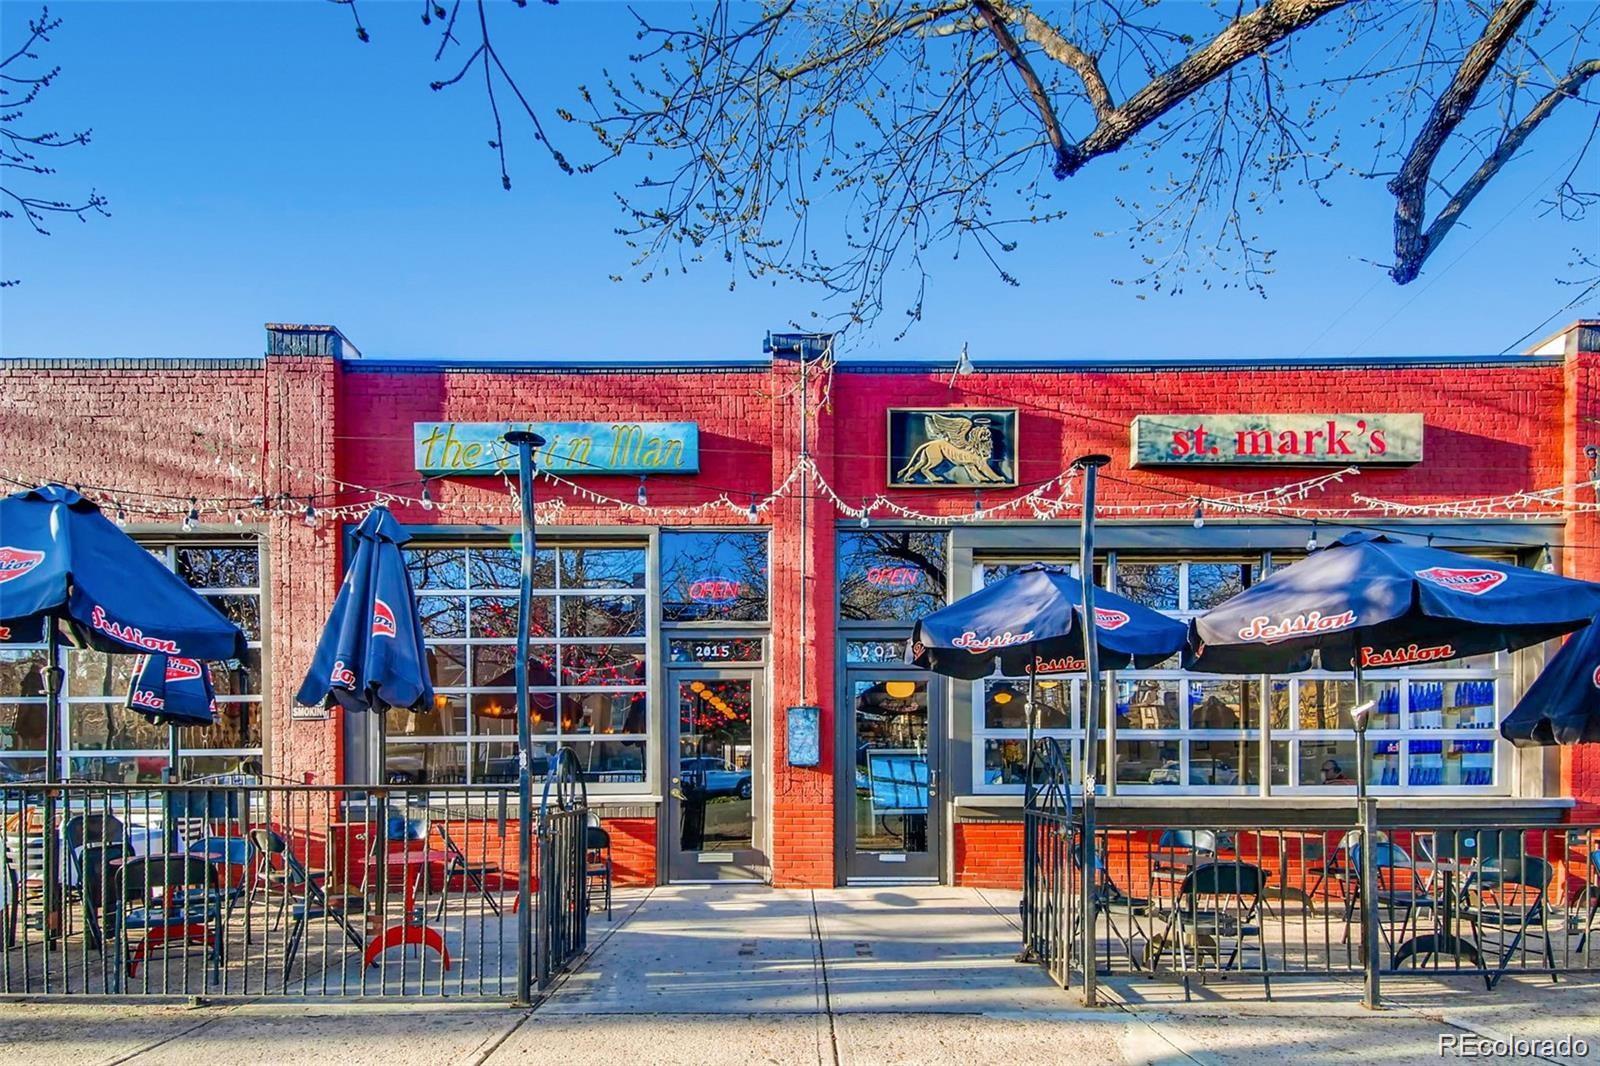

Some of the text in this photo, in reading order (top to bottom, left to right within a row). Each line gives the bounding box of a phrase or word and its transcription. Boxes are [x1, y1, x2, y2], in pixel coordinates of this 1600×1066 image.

[421, 423, 685, 469] the tin Man
[1171, 420, 1387, 456] st. mark's
[866, 567, 918, 585] OPEN
[689, 581, 740, 599] OPEN
[92, 605, 181, 654] Session
[1239, 610, 1358, 641] Session
[695, 645, 730, 658] 2015
[952, 631, 1036, 649] Session
